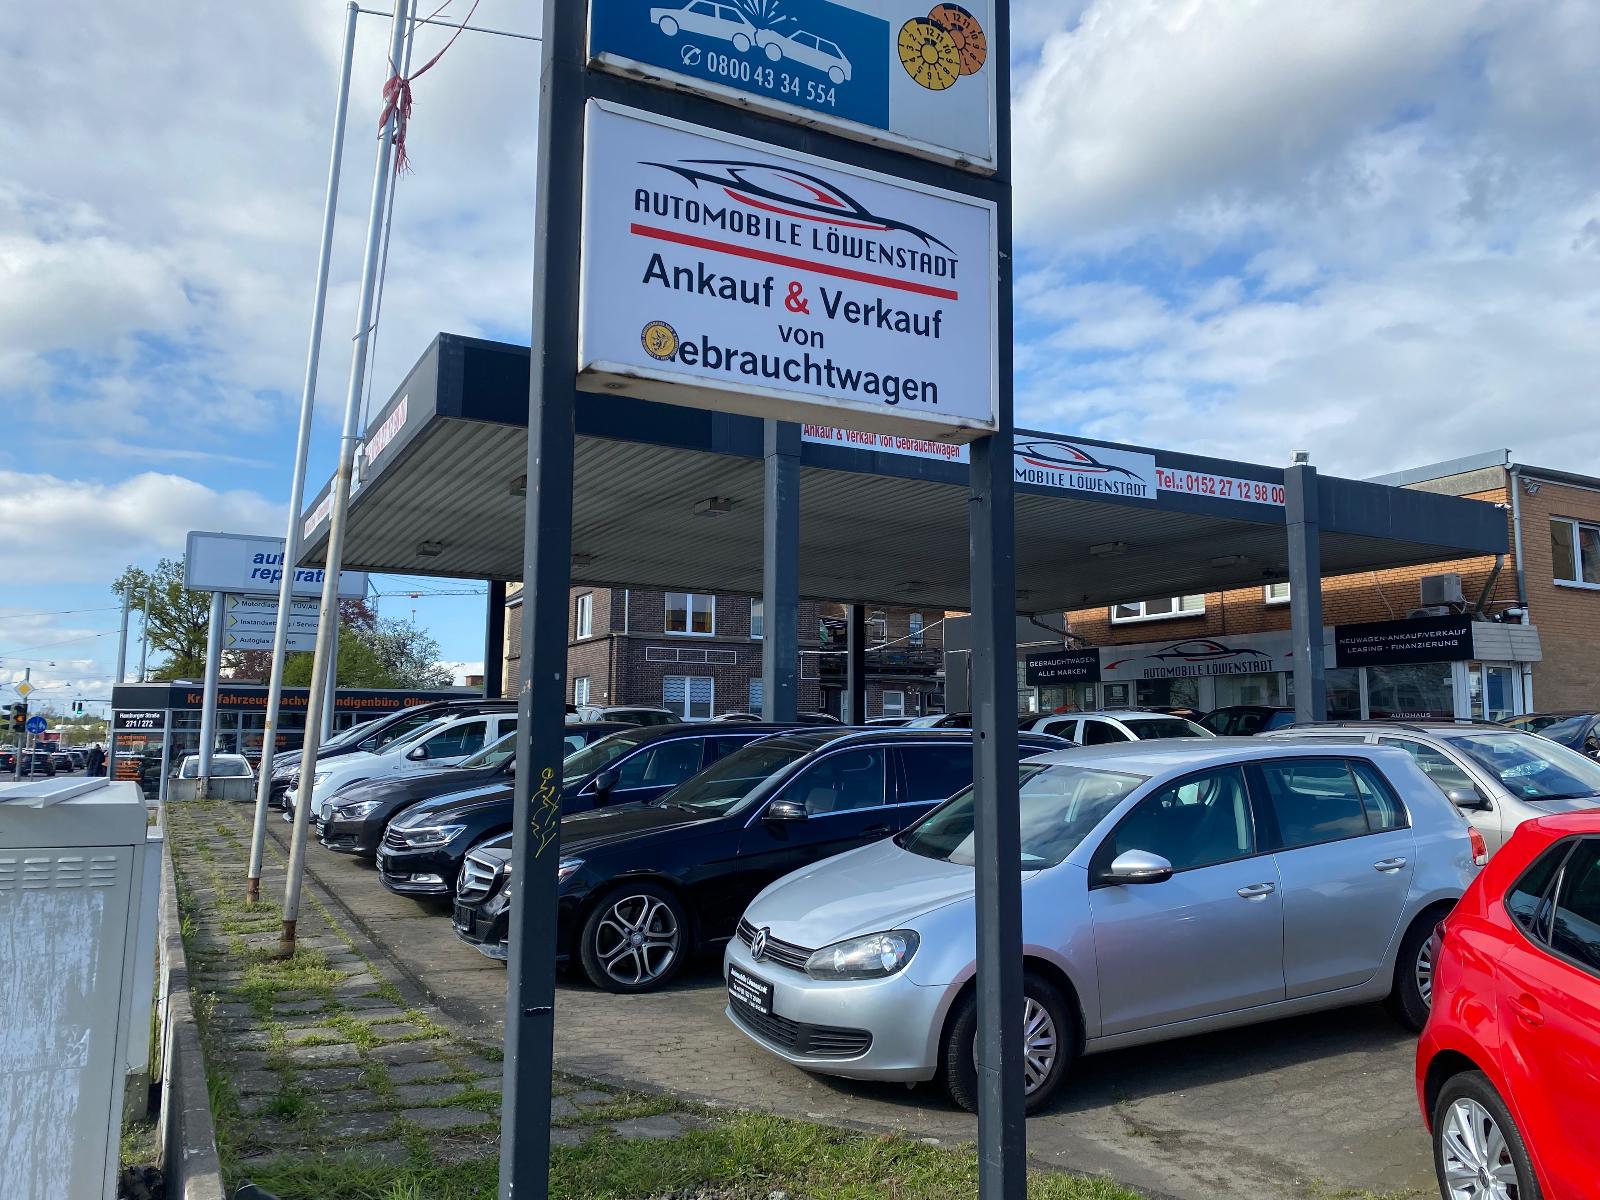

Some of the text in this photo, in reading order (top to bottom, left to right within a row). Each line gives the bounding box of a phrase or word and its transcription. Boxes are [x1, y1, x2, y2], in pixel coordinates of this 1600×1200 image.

[707, 51, 836, 107] 0800 43 34 554
[634, 188, 959, 280] AUTOMOBILE LÖWENSTADT
[642, 253, 943, 339] Ankauf & Verkauf
[778, 324, 824, 349] von
[669, 335, 938, 405] ebrauchtwagen
[804, 424, 960, 460] Ankauf & Verkauf von Gebrauchtwagen
[1015, 467, 1147, 497] MOBILE LÖWENSTADT
[1156, 470, 1285, 504] Tel.: 0152 27 12 98 00
[252, 552, 285, 566] aut
[251, 567, 342, 584] reprat
[241, 600, 280, 608] Motordiagn
[1347, 645, 1383, 654] LEASING
[1391, 639, 1459, 651] FINANZIERUNG
[1029, 657, 1095, 668] GEBRAUCHTWAGEN
[1057, 668, 1087, 676] MARKEN
[1143, 659, 1273, 679] AUTOMOBILE LÖWENSTADT
[125, 720, 137, 728] 271
[141, 720, 153, 728] 272
